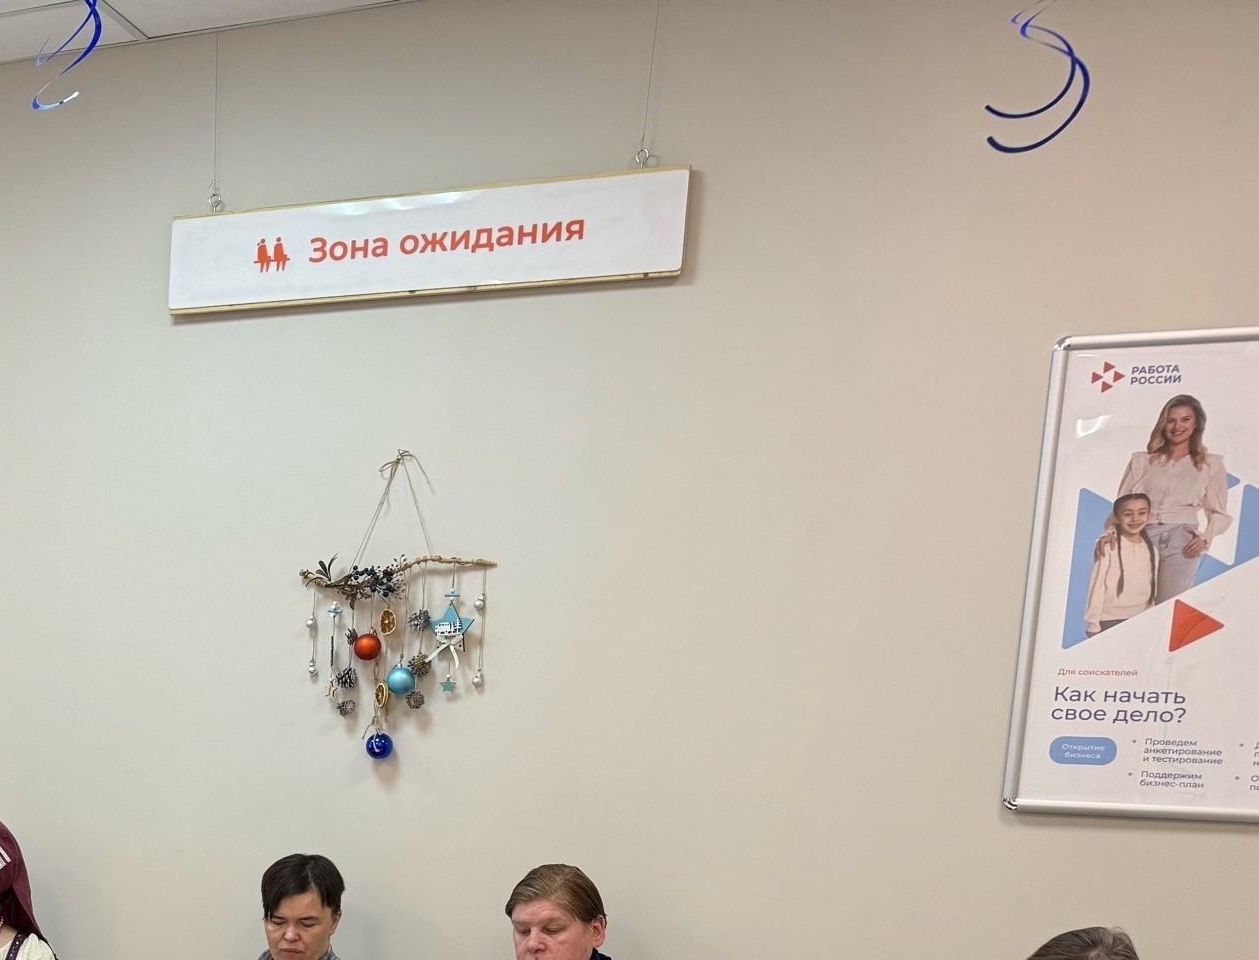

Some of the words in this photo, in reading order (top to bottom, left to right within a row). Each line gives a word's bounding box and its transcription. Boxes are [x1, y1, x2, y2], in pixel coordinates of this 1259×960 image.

[308, 234, 389, 264] Зона
[399, 218, 585, 256] ожидания
[1131, 365, 1180, 374] РАБОТА
[1130, 375, 1181, 384] РОССИИ
[1057, 668, 1076, 677] Для
[1078, 668, 1138, 677] соискателей
[1054, 686, 1096, 703] Как
[1104, 690, 1186, 704] начать
[1051, 708, 1107, 721] свое
[1113, 707, 1187, 724] дело?
[1061, 743, 1106, 752] Открытие
[1145, 738, 1198, 748] Проведем
[1064, 751, 1101, 760] бизнеса
[1143, 748, 1222, 757] анкетирование
[1152, 756, 1223, 766] тестирование
[1141, 771, 1202, 780] Поддержим
[1140, 779, 1204, 789] бизнес-план
